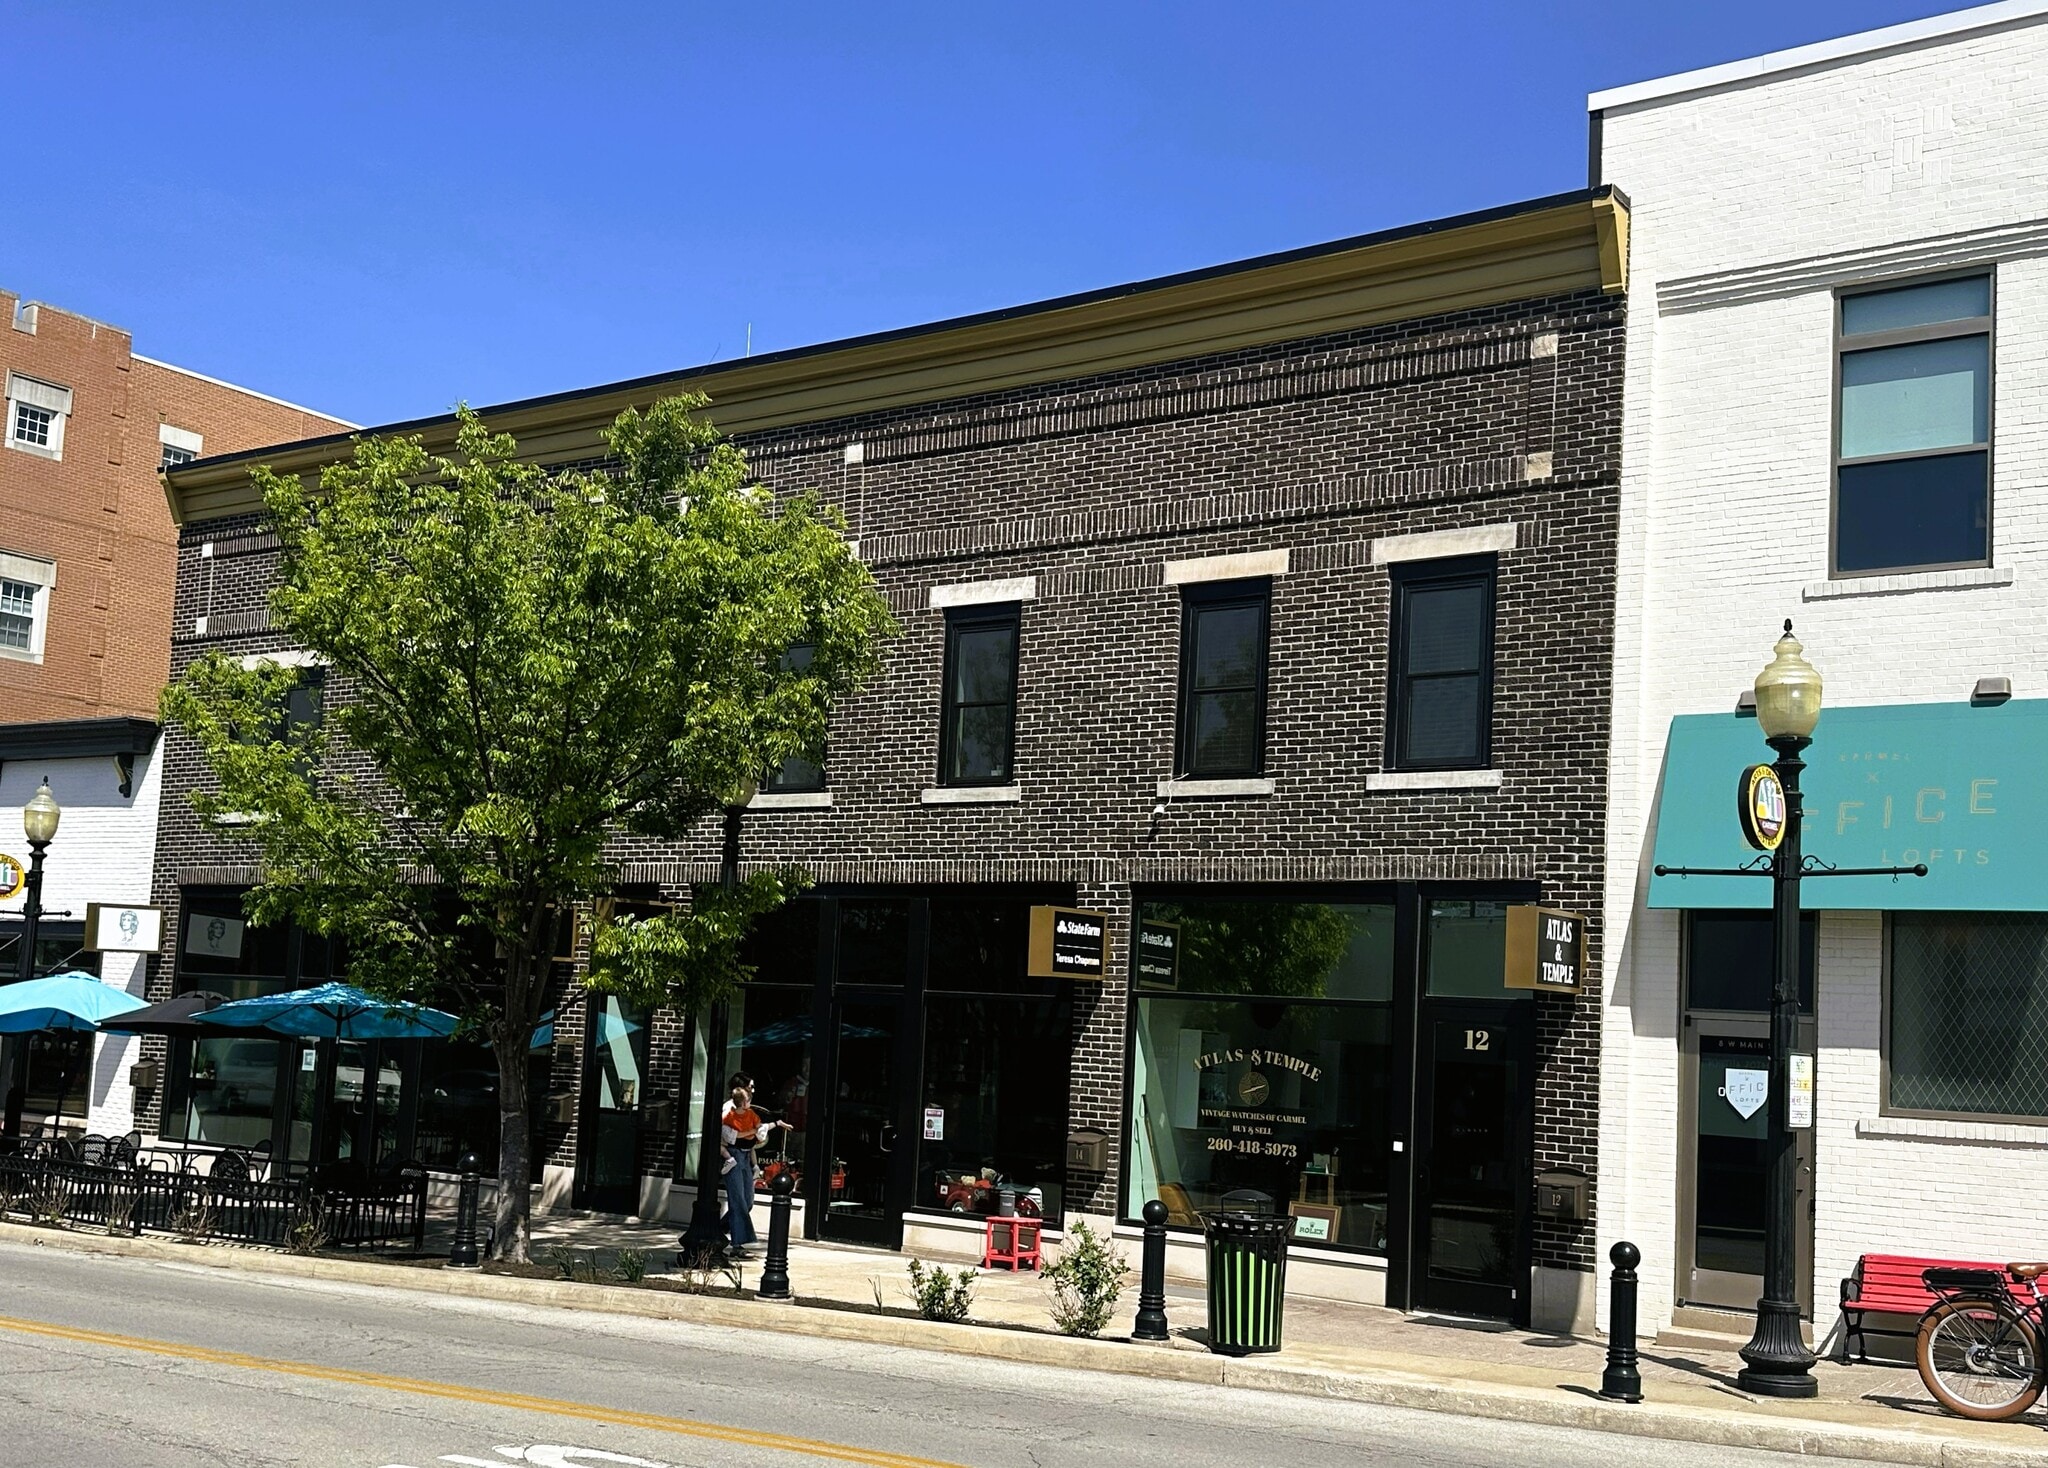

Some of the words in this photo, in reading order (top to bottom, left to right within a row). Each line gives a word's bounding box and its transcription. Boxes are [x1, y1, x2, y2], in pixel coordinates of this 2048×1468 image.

[1881, 849, 1990, 865] LOFTS
[1546, 918, 1573, 943] ATLAS
[1055, 953, 1074, 964] Teresa
[1555, 943, 1563, 962] &
[1542, 962, 1574, 984] TEMPLE
[1464, 1030, 1490, 1051] 12
[1193, 1049, 1244, 1072] ATLAS
[1251, 1049, 1262, 1066] &
[1264, 1050, 1322, 1082] TEMPLE
[1717, 1082, 1764, 1097] OFFIC
[1201, 1108, 1231, 1118] VINTAGE
[1231, 1111, 1265, 1121] WATCHES
[1266, 1113, 1276, 1122] OF
[1276, 1114, 1307, 1124] CARMEL
[1232, 1125, 1247, 1133] BUY
[1248, 1126, 1254, 1135] &
[1255, 1127, 1273, 1135] SELL
[1207, 1137, 1298, 1158] 260-418-5973
[1552, 1194, 1562, 1206] 12
[1299, 1226, 1325, 1236] ROLEX
